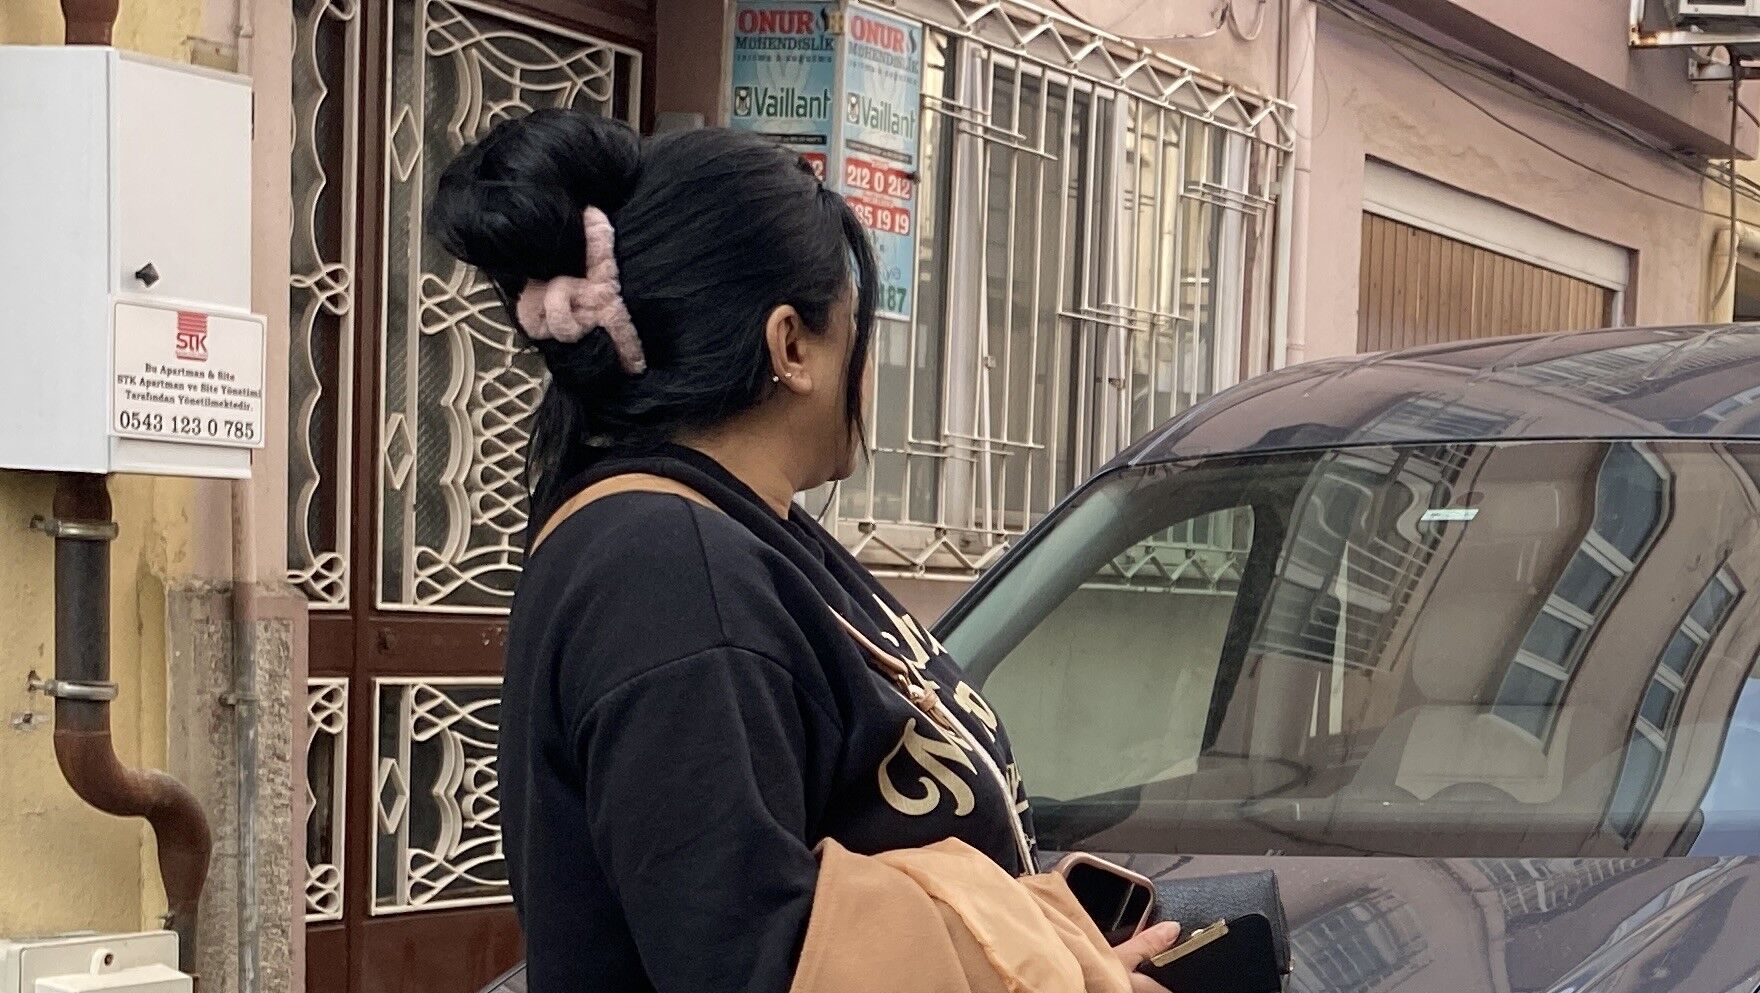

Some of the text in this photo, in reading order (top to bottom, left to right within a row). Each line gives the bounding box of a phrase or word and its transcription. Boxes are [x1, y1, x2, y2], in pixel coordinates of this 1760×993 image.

[736, 9, 814, 35] ONUR
[851, 15, 904, 54] ONUR
[754, 86, 833, 119] Vaillant
[861, 96, 916, 139] Vaillant
[847, 164, 871, 189] 212
[873, 172, 885, 192] 0
[888, 175, 912, 200] 212
[876, 209, 892, 231] 19
[894, 213, 910, 235] 19
[176, 332, 208, 352] STK
[117, 374, 262, 398] STK Apartman ve Site Yönetimi
[160, 365, 205, 379] Apartman
[217, 371, 236, 382] Site
[125, 389, 175, 404] Tarafından
[119, 410, 255, 440] 0543 123 0 785
